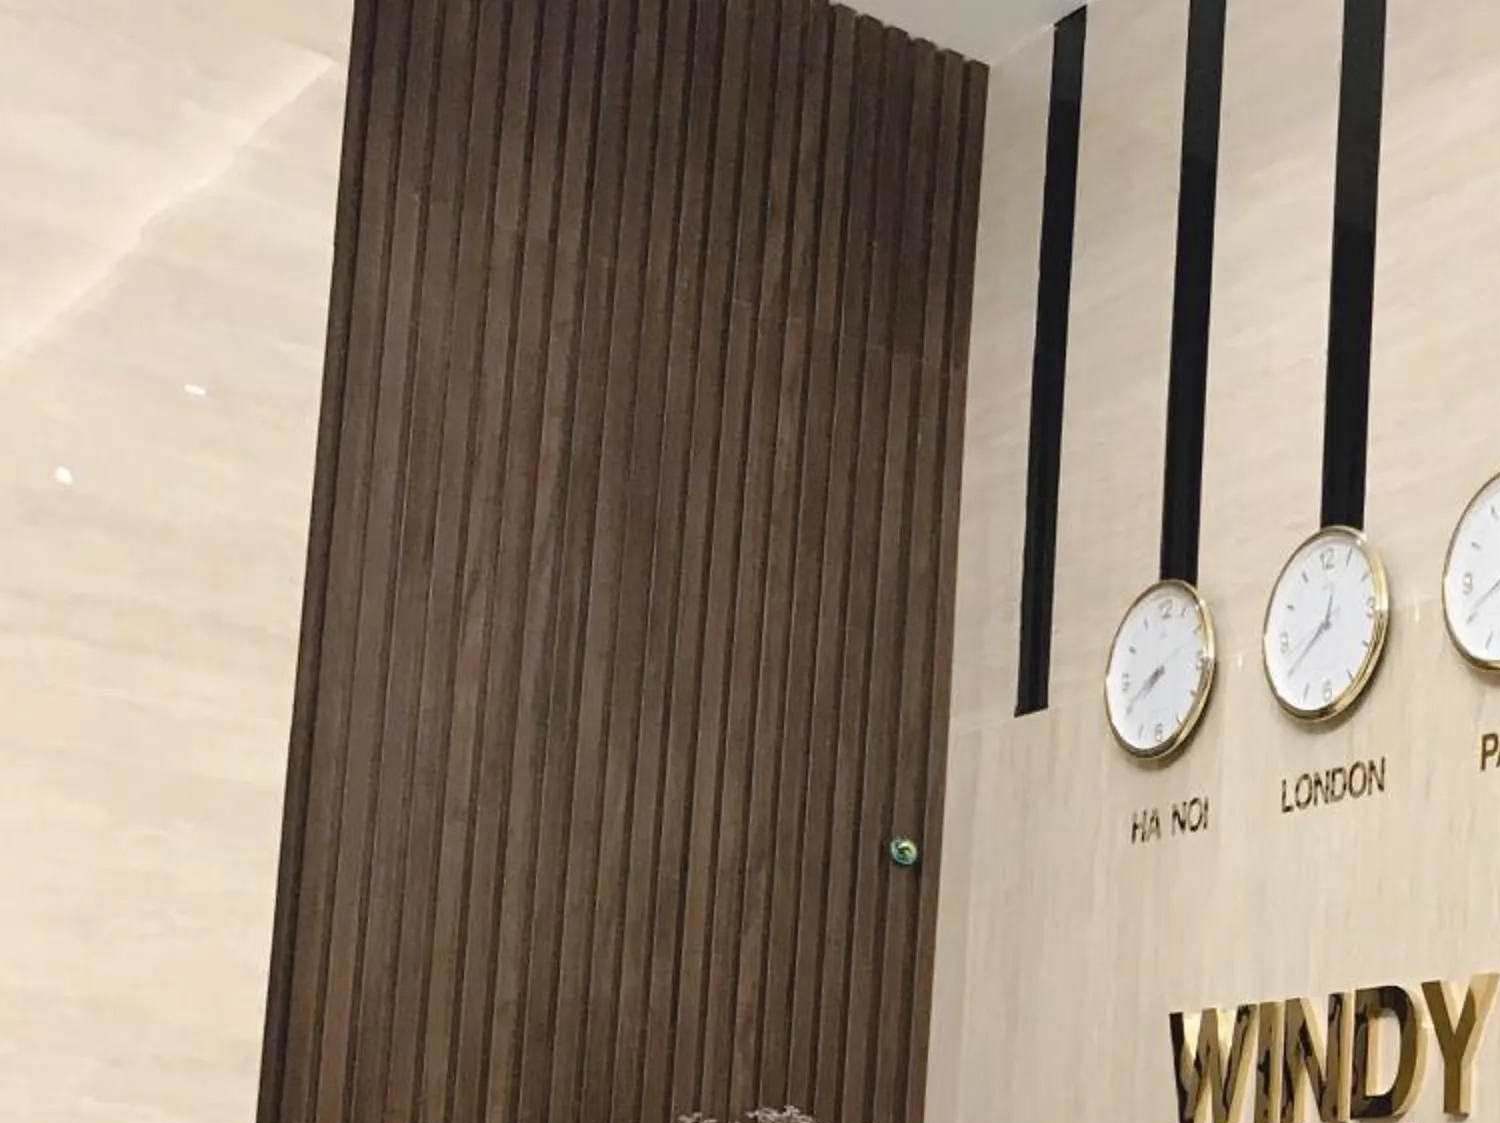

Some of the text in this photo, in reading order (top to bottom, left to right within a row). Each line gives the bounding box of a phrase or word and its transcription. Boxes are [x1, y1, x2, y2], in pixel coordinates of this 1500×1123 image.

[1280, 756, 1386, 813] LONDON
[1131, 798, 1209, 844] HA NOI
